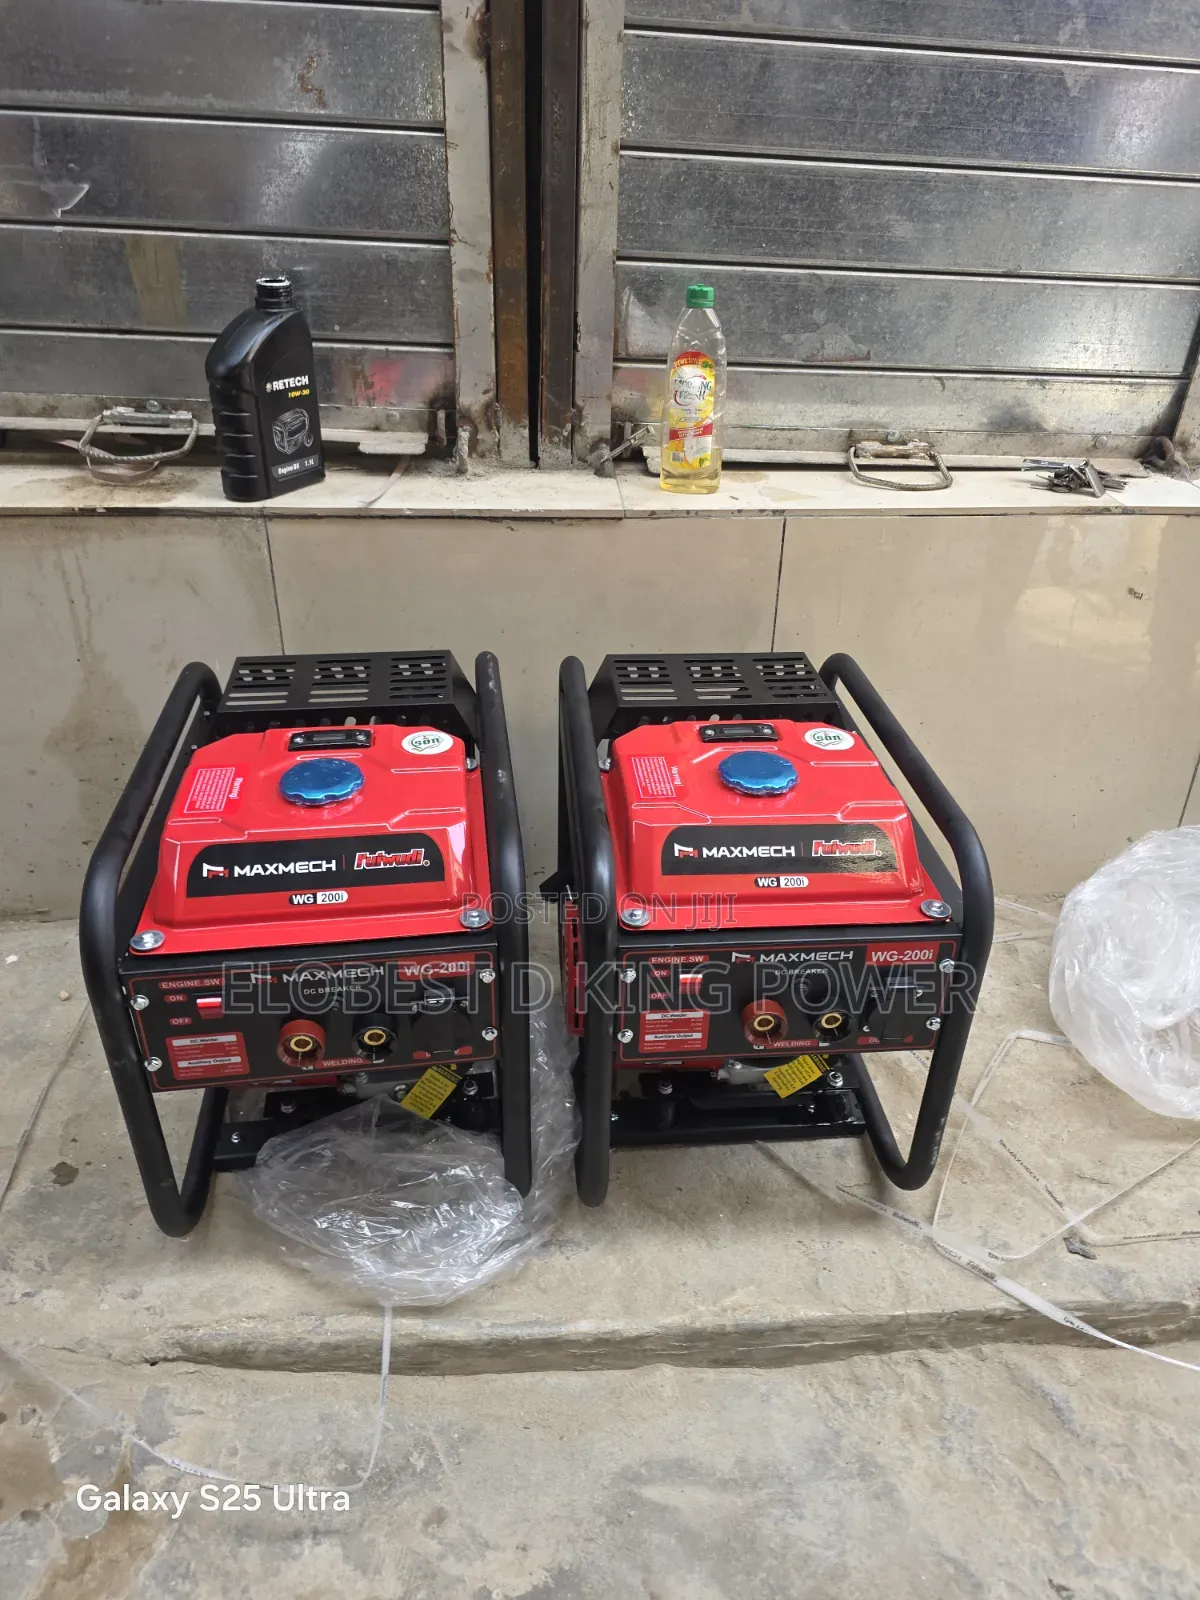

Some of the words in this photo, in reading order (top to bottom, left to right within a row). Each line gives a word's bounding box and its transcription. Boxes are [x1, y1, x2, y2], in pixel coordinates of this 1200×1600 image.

[272, 375, 309, 392] RETECH
[288, 388, 310, 398] 10W-30
[702, 845, 795, 858] MAXMECH
[234, 860, 336, 878] MAXMECH
[757, 877, 777, 887] WG
[783, 877, 805, 887] 200i
[292, 894, 314, 905] WG
[320, 892, 344, 903] 200i
[651, 956, 704, 964] ENGINE.SW
[760, 951, 854, 963] MAXMECH
[871, 950, 934, 962] WG-200i
[282, 966, 384, 983] MAXMECH
[404, 961, 470, 976] WG-200i
[162, 979, 220, 989] ENGINE.SW
[318, 986, 361, 994] BREAKER
[774, 1040, 811, 1048] WELDING
[322, 1057, 363, 1067] WELDING
